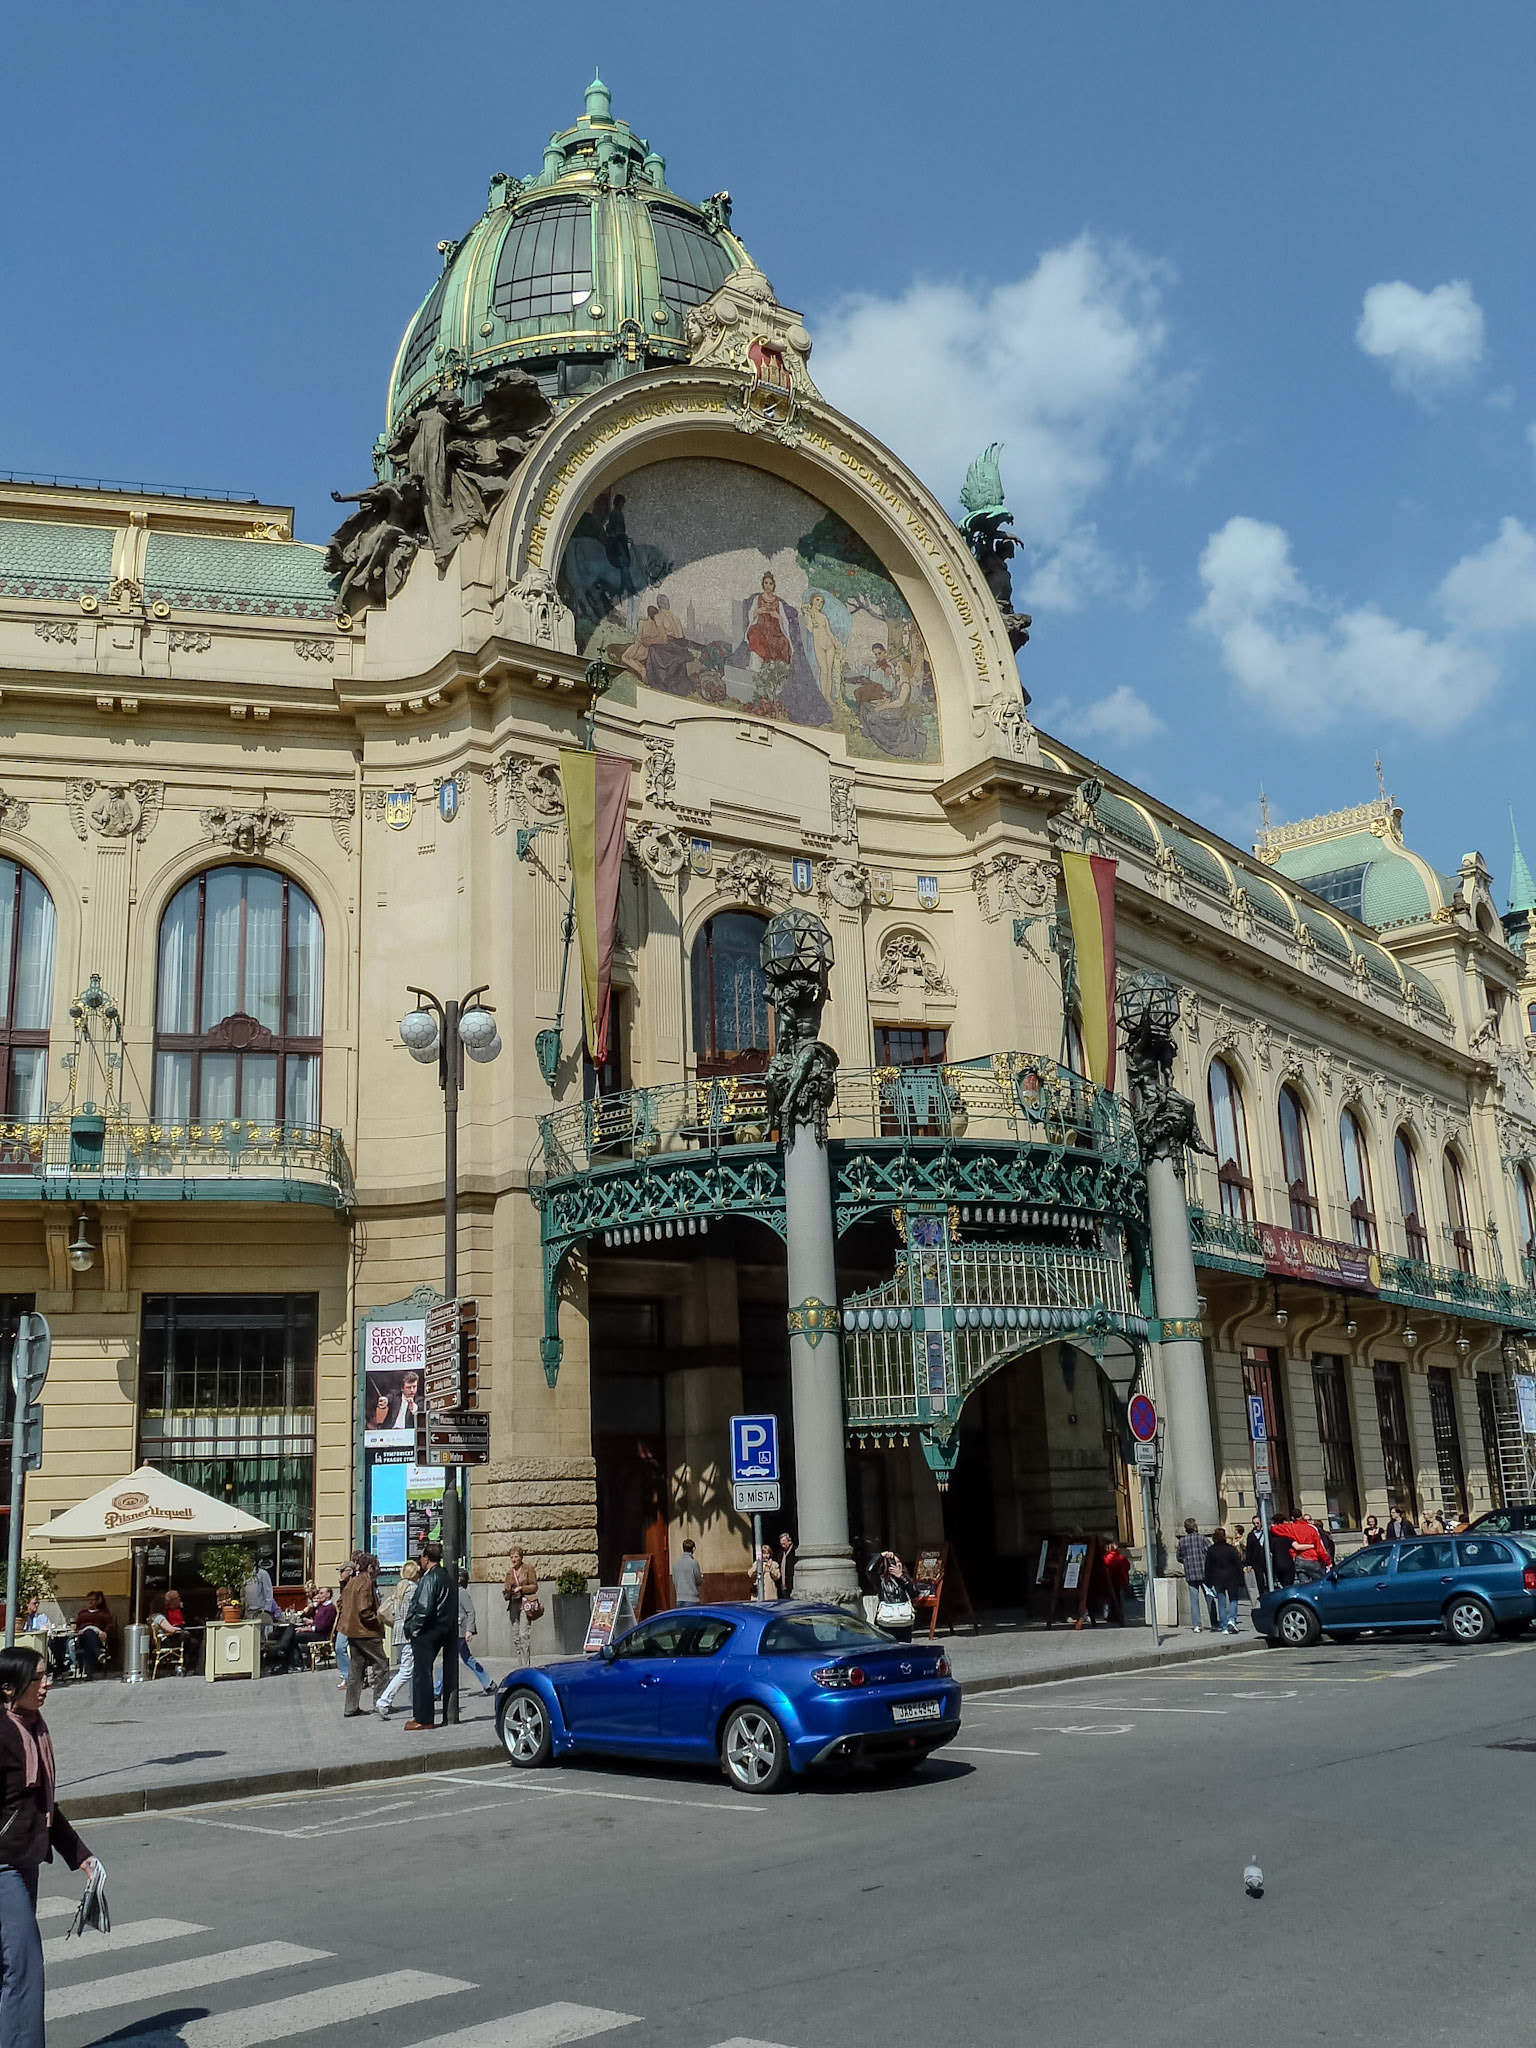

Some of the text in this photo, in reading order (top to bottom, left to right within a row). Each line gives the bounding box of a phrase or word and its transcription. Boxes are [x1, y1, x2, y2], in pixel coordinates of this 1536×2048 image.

[804, 431, 832, 455] JAK
[525, 522, 548, 567] ZDAR
[1301, 1243, 1341, 1271] KORUNA
[372, 1326, 404, 1337] ČESKÝ
[372, 1344, 424, 1355] SYMFONIC
[372, 1353, 422, 1364] ORCHESTR
[1253, 1402, 1261, 1426] P
[741, 1425, 766, 1461] P
[739, 1489, 775, 1502] 3 MÍSTA
[105, 1506, 193, 1529] Pilsner Urquell
